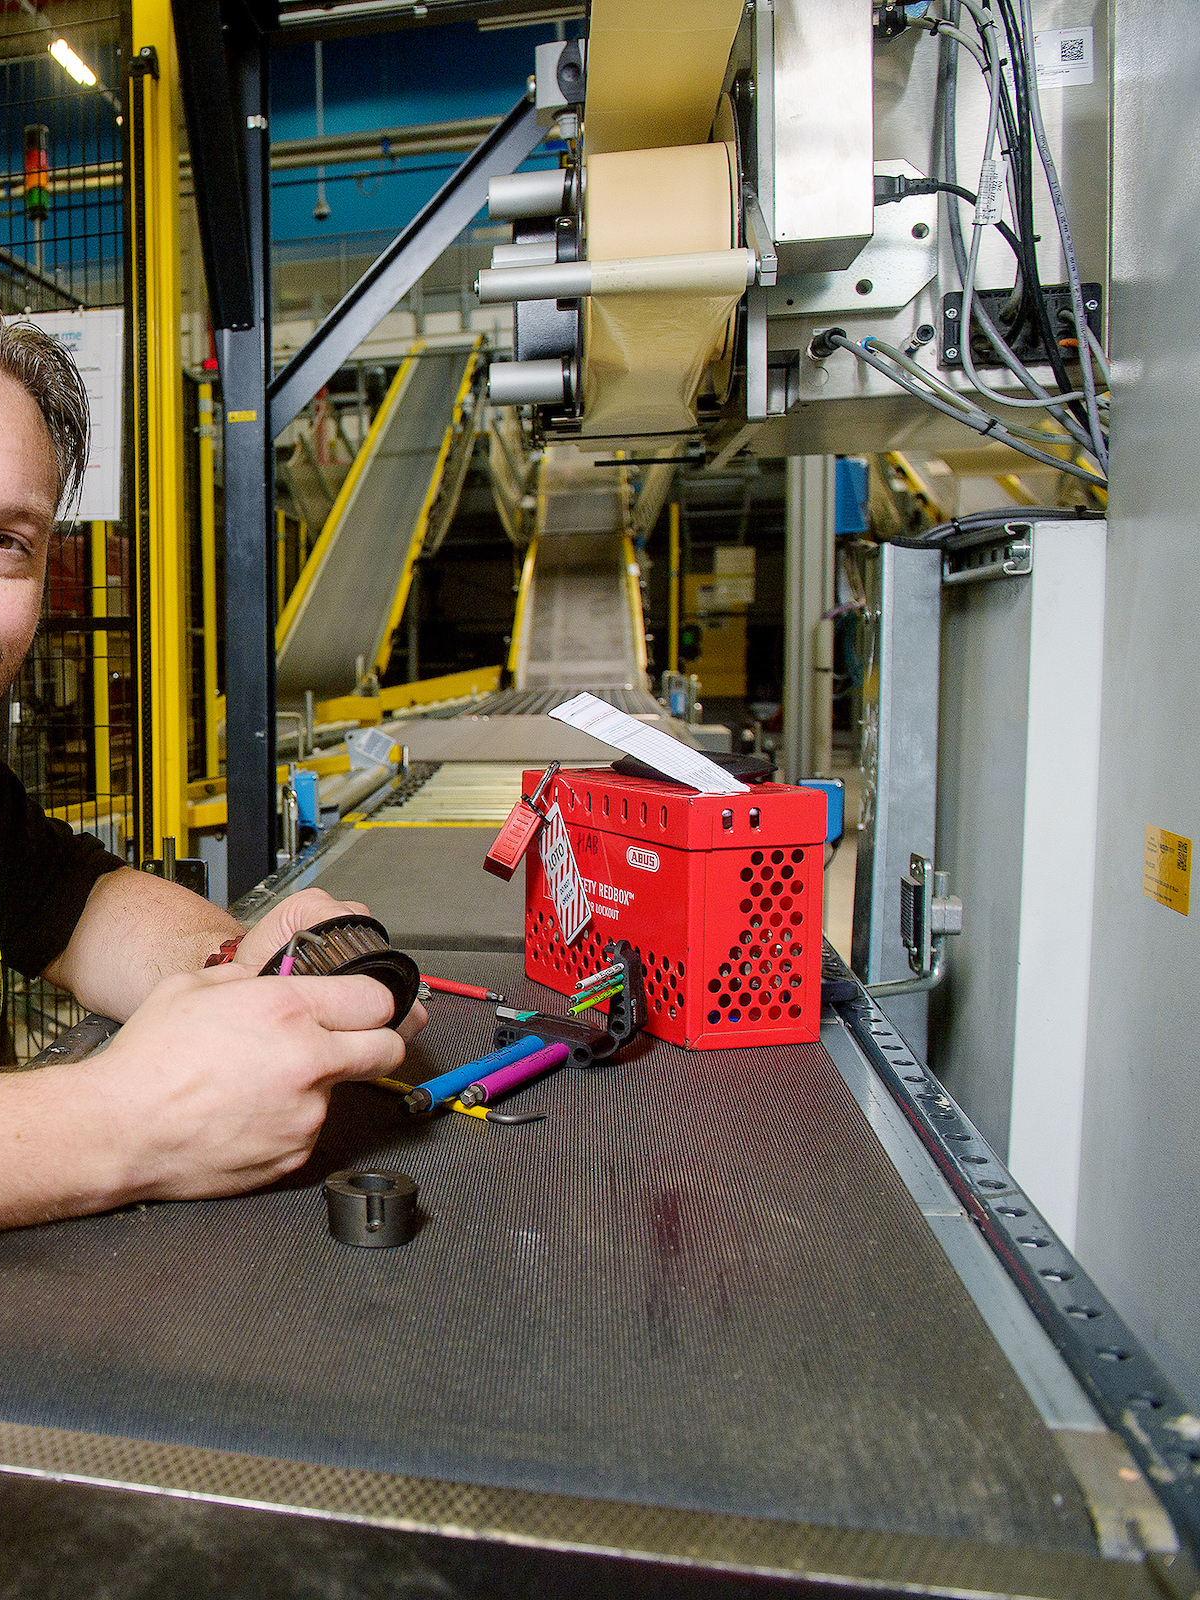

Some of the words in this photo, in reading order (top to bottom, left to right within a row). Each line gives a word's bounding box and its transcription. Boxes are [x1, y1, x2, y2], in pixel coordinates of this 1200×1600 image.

[577, 832, 598, 855] HAB
[548, 843, 565, 871] LOTO
[631, 851, 655, 867] ABUS
[580, 876, 597, 895] ETY
[595, 903, 620, 921] LOCKOUT
